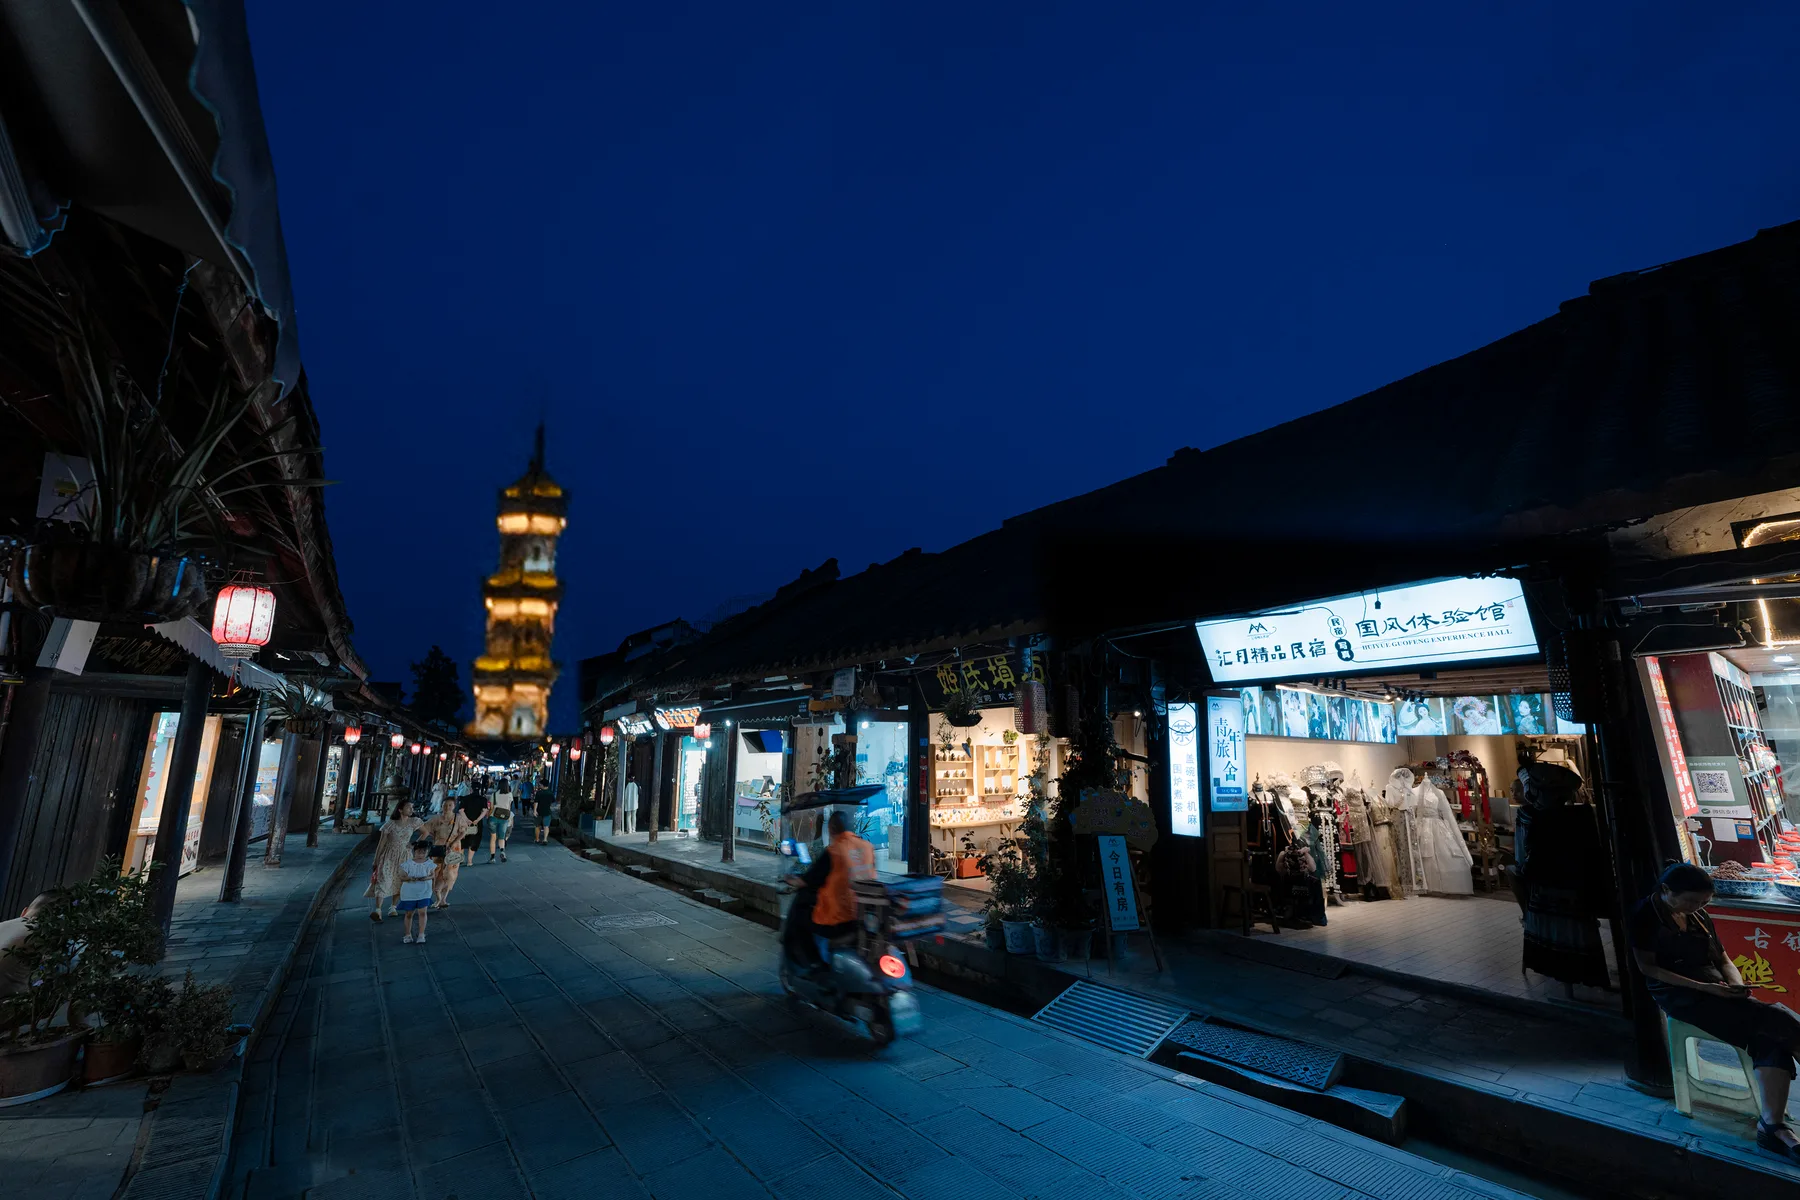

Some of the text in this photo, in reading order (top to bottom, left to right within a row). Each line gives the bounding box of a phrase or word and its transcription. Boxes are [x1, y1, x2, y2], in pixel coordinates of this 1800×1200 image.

[1355, 602, 1505, 638] 国风体验馆
[1215, 638, 1326, 667] 汇月精品民宿
[1362, 628, 1513, 650] HUIYUE GUOFENG EXPERIENCE HALL
[1214, 717, 1242, 782] 青年旅舍
[1187, 801, 1198, 825] 机麻
[1109, 850, 1128, 912] 今日有房
[1733, 950, 1800, 993] 熊
